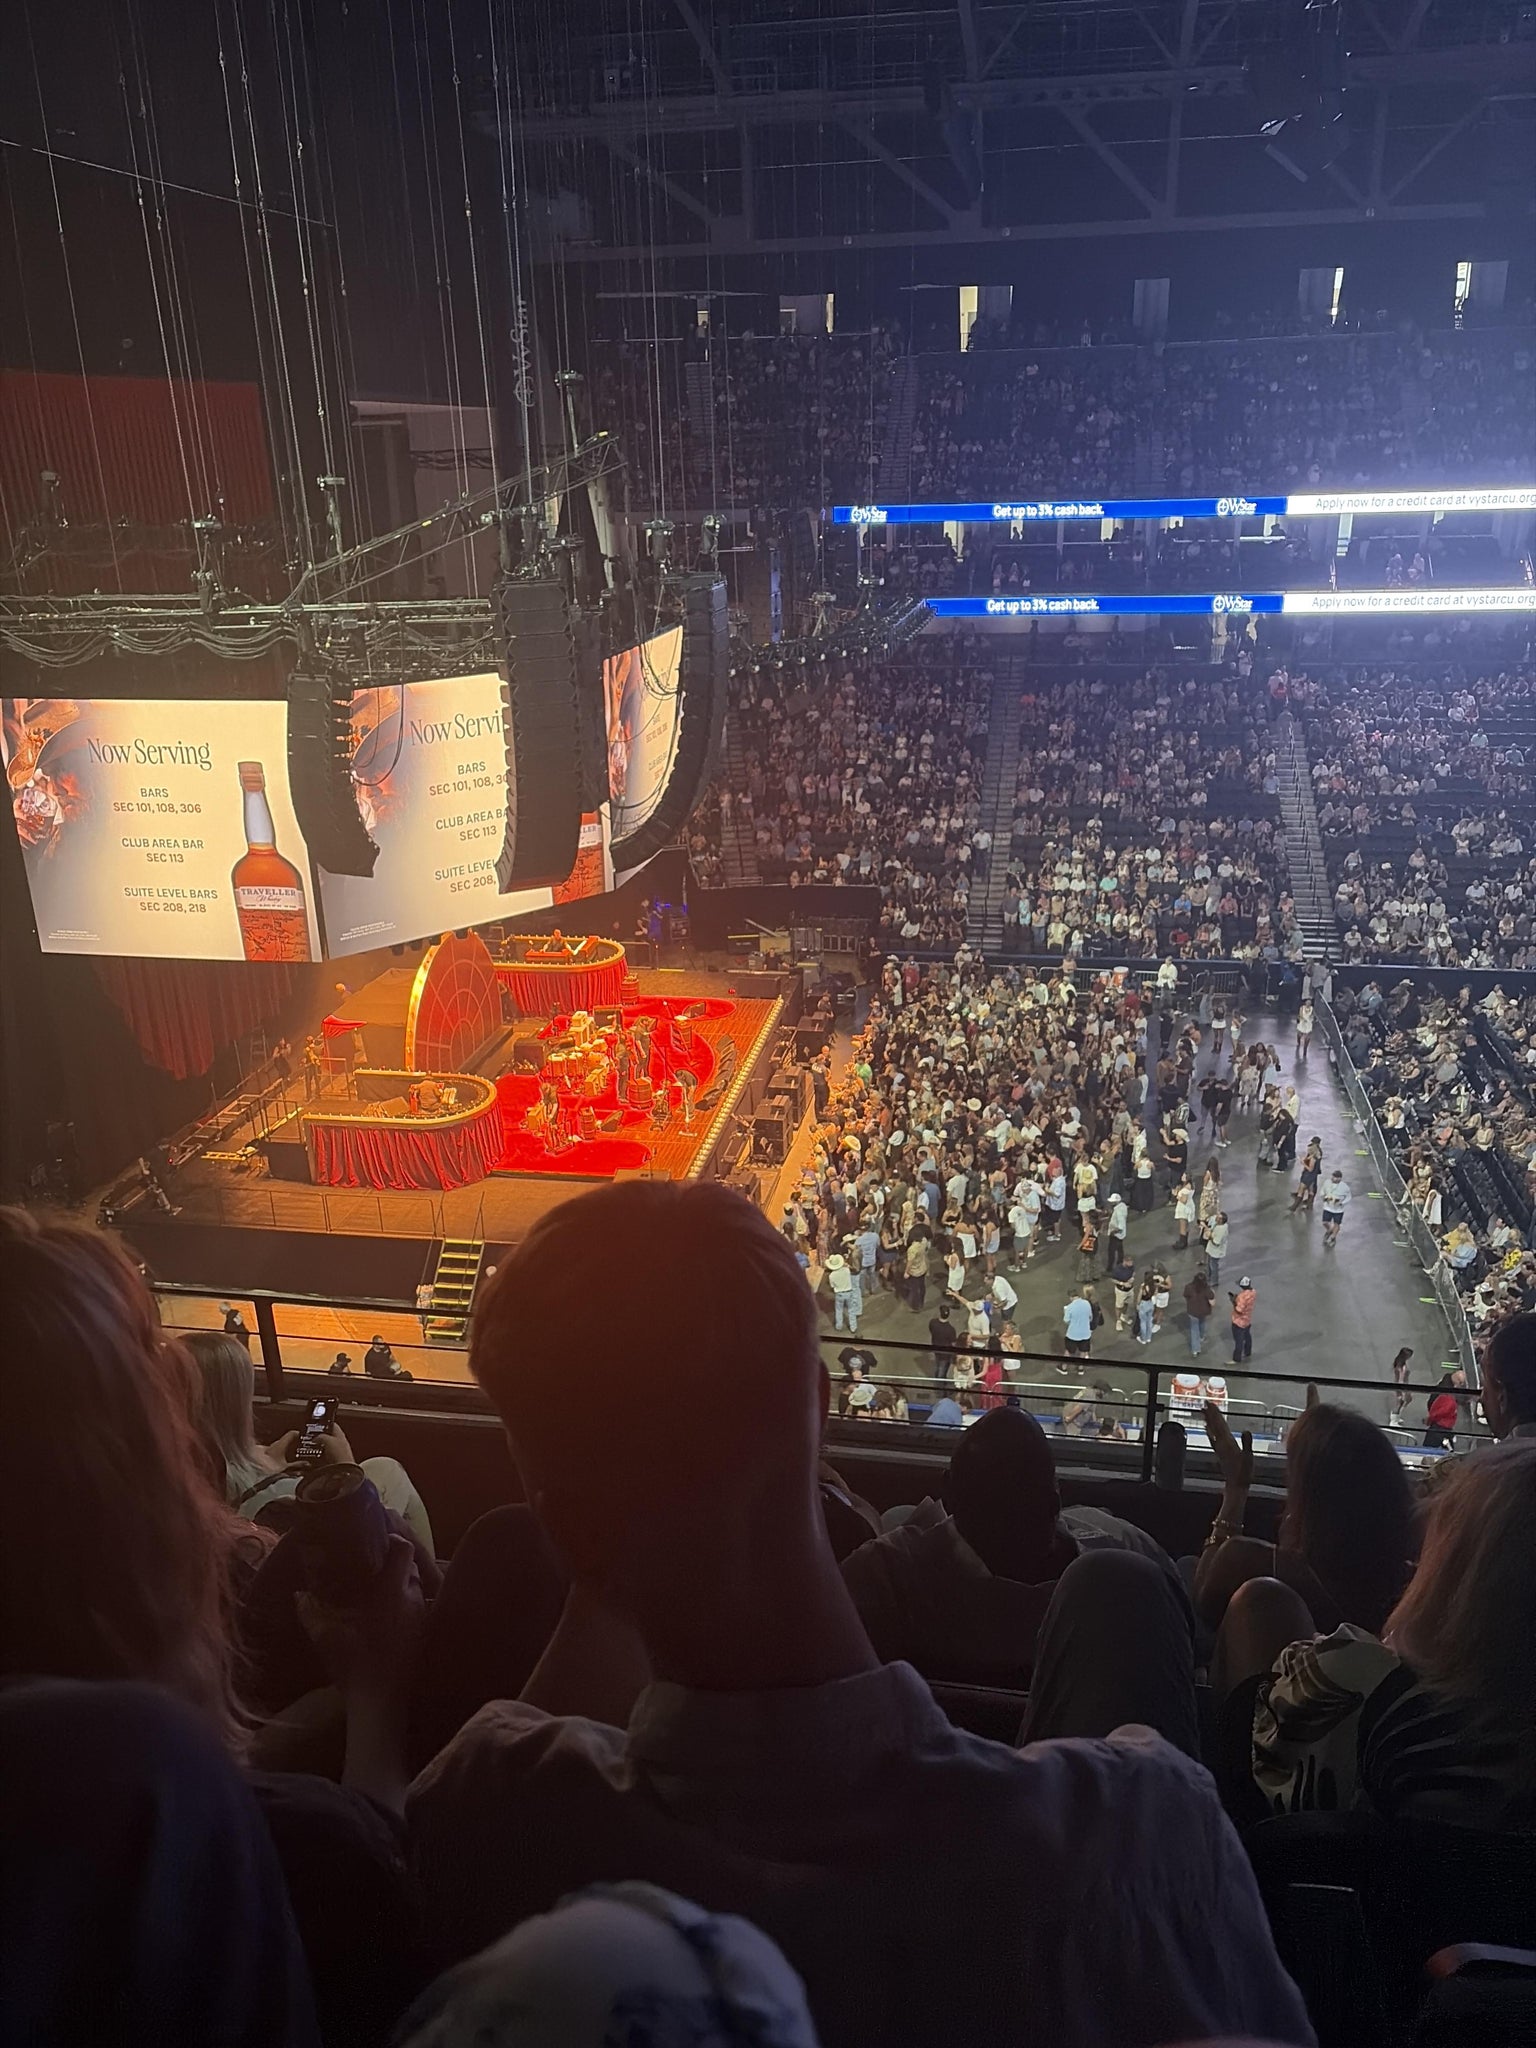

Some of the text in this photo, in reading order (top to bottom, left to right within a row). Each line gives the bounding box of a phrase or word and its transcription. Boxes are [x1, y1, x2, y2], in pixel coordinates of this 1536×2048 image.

[1230, 498, 1257, 513] VyStar
[1316, 498, 1344, 511] Apply
[1347, 499, 1368, 508] now
[1371, 496, 1387, 507] for
[1396, 496, 1428, 507] credit
[1430, 495, 1454, 505] card
[1455, 495, 1466, 505] at
[994, 503, 1104, 520] Get up to 3% cash back.
[988, 598, 1099, 614] Get up to 3% cash back.
[1226, 596, 1253, 610] VyStar
[1312, 596, 1340, 609] Apply
[1343, 597, 1365, 606] now
[1368, 595, 1383, 606] for
[1393, 596, 1425, 606] credit
[1427, 595, 1451, 605] card
[1453, 595, 1464, 605] at
[410, 710, 501, 746] Now Servi
[88, 738, 212, 771] Now Serving
[457, 761, 486, 775] BARS
[140, 788, 169, 798] BARS
[429, 784, 451, 796] SEC
[452, 780, 471, 791] 101,
[473, 776, 494, 788] 108,
[113, 802, 202, 814] SEC 101, 108, 306
[435, 816, 464, 830] CLUB
[466, 810, 494, 824] AREA
[459, 825, 497, 842] SEC 113
[122, 838, 204, 849] CLUB AREA BAR
[146, 853, 184, 863] SEC 113
[434, 865, 465, 881] SUITE
[450, 874, 497, 893] SEC 208,
[124, 887, 218, 899] SUITE LEVEL BARS
[241, 888, 296, 897] TRAVELLER
[140, 901, 207, 914] SEC 208, 218
